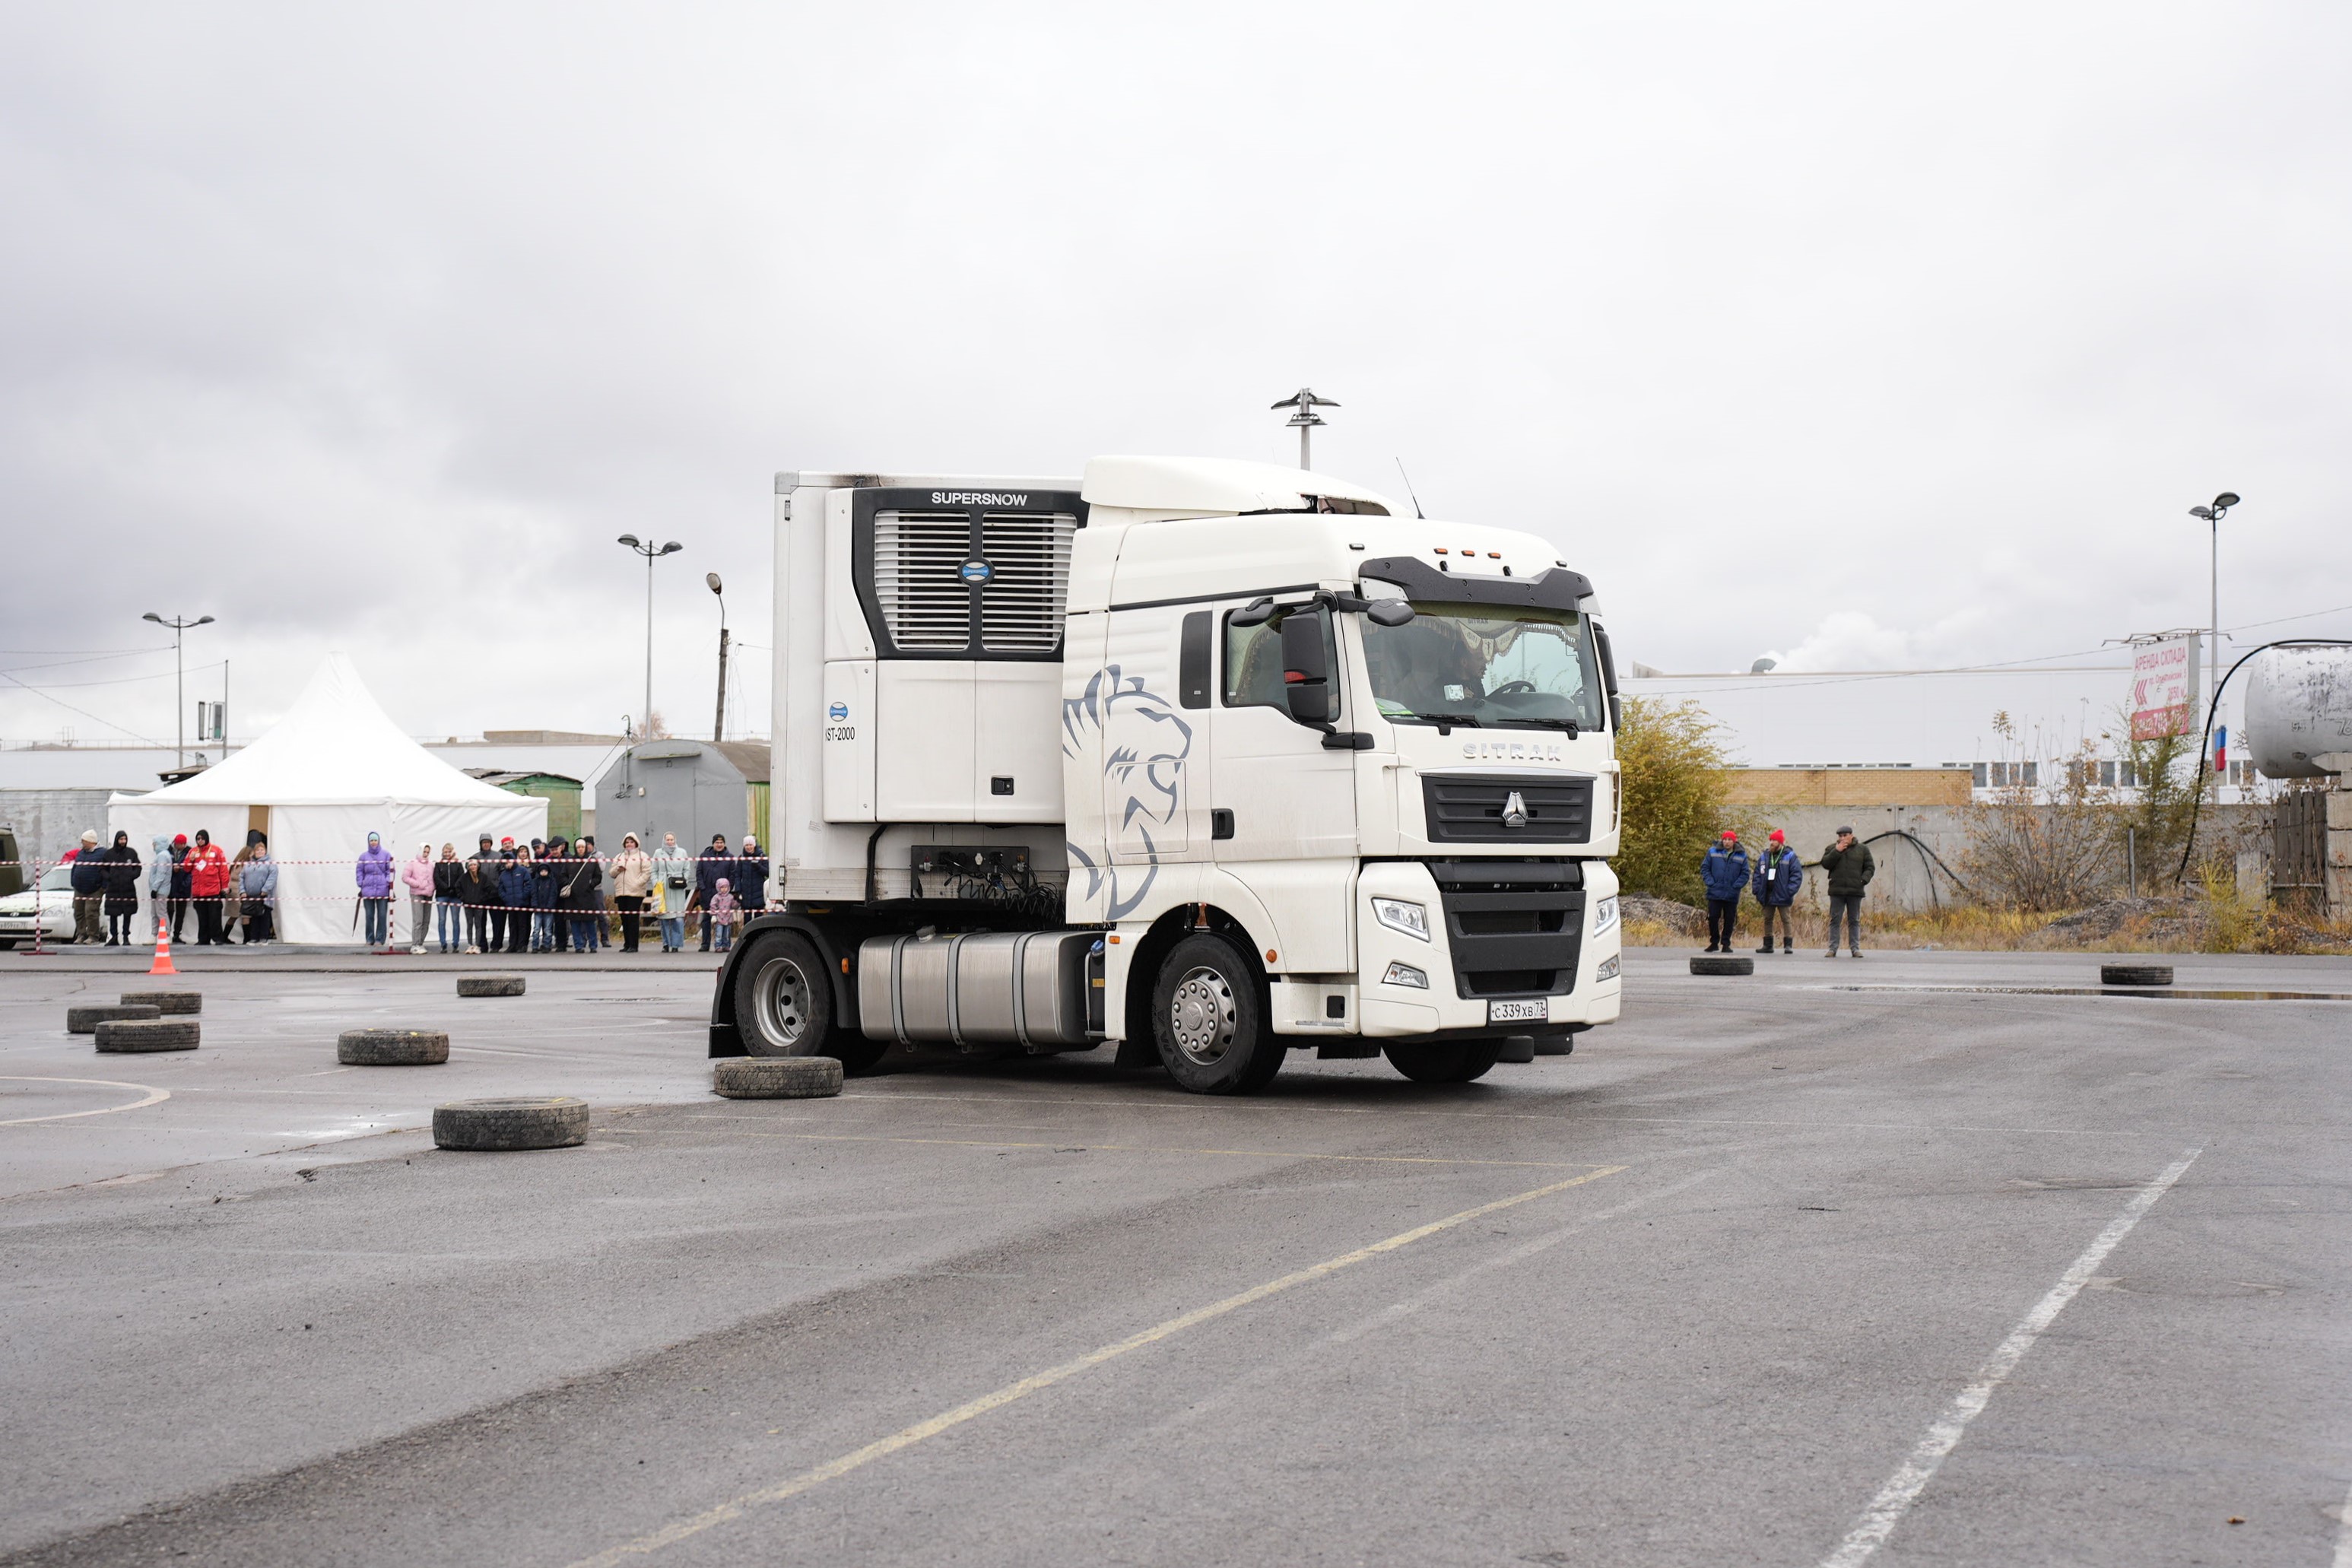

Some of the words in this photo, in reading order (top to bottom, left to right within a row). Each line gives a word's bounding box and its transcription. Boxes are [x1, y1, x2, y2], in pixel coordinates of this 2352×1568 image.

[932, 491, 1027, 506] SUPERSNOW
[2135, 653, 2159, 671] АРЕНДА
[2161, 646, 2187, 666] СКЛАДА
[1463, 743, 1561, 761] SITRAK
[1535, 1001, 1544, 1013] 73
